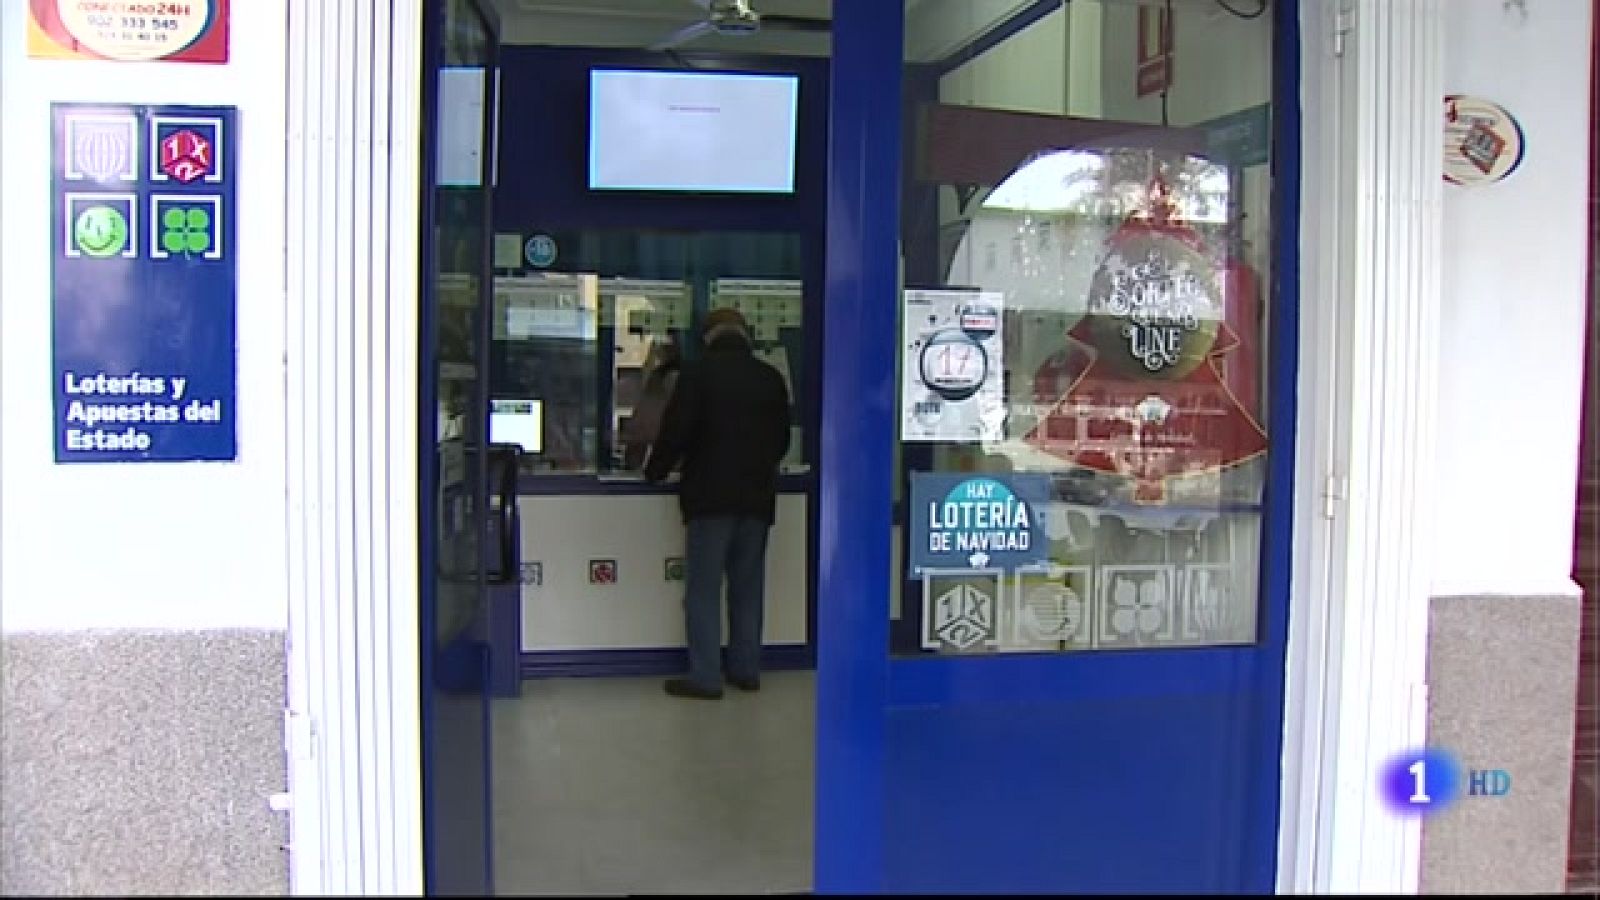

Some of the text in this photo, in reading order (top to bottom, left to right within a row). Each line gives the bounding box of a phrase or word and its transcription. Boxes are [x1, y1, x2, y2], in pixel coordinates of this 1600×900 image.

[121, 17, 146, 28] 333
[151, 17, 179, 31] 545
[65, 372, 187, 400] Loterías y
[67, 400, 221, 427] Apuestas del
[66, 427, 151, 450] Estado
[967, 483, 994, 498] HAY
[929, 494, 1029, 528] LOTERÍA
[929, 531, 1029, 551] DE NAVIDAD
